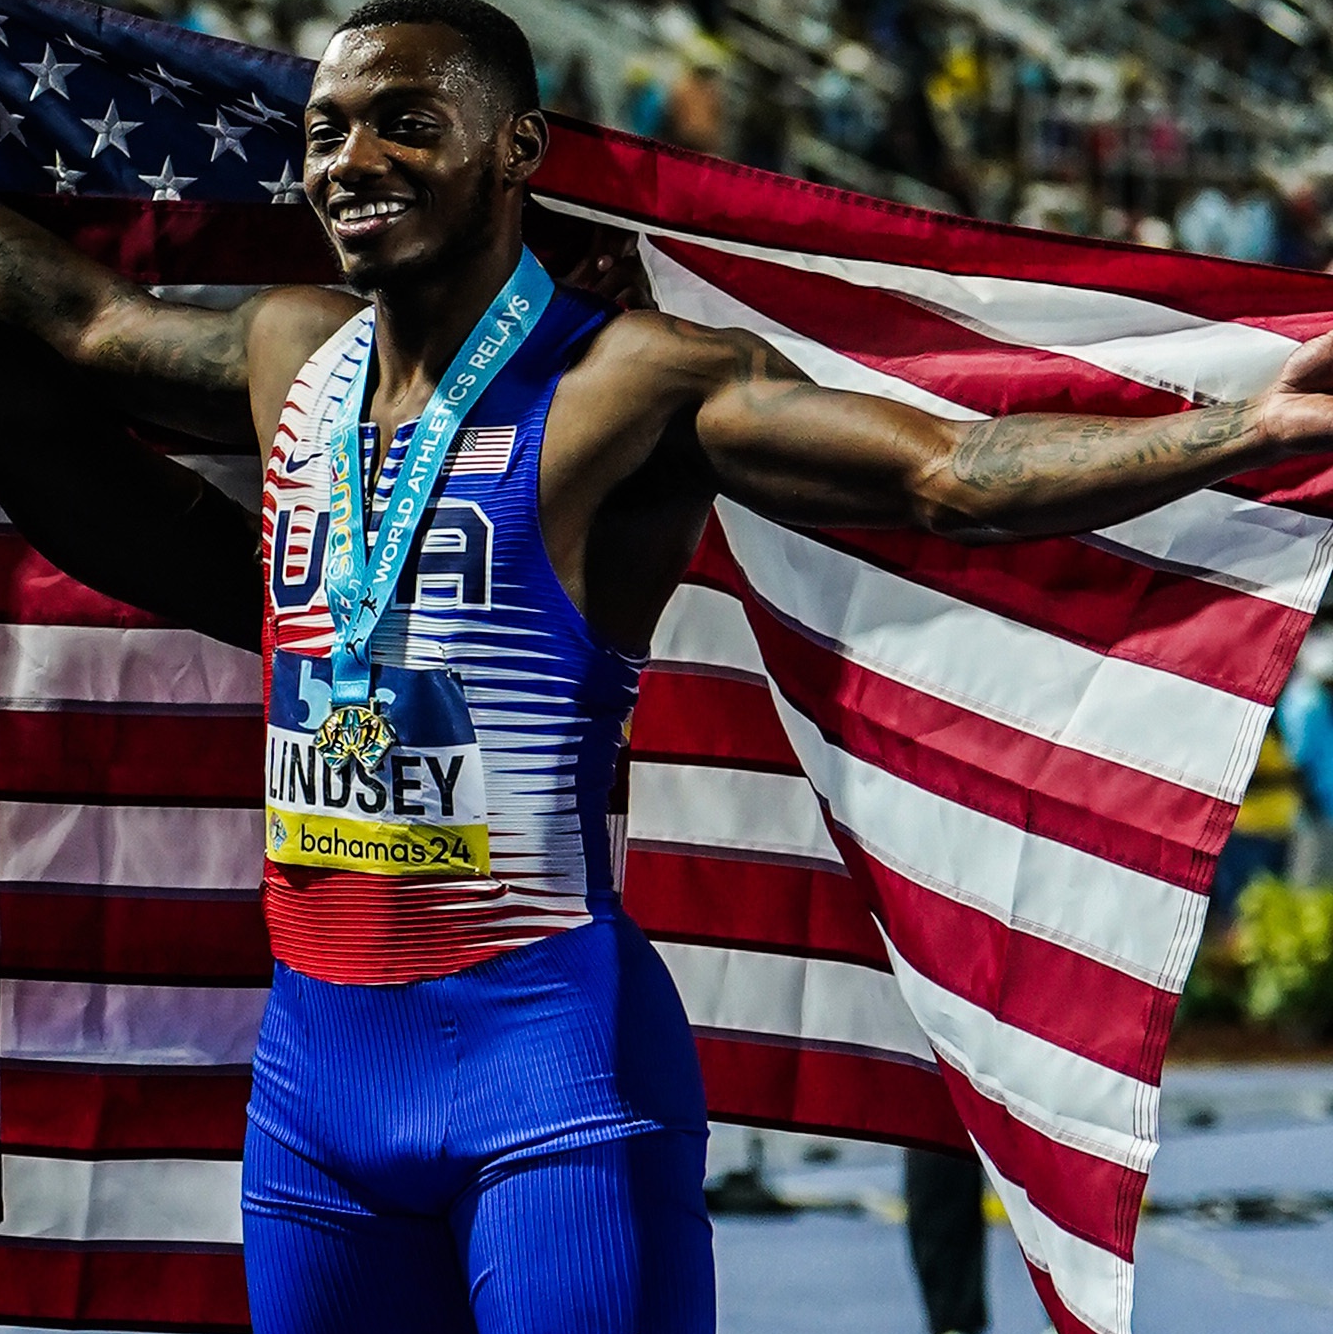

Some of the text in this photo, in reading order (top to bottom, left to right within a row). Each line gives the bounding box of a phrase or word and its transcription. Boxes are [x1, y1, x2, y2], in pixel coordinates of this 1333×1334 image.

[373, 293, 531, 585] WORLD ATHLETICS RELAYS
[269, 498, 494, 612] UA
[269, 736, 465, 817] LINDSEY
[300, 823, 471, 864] bahamas24
